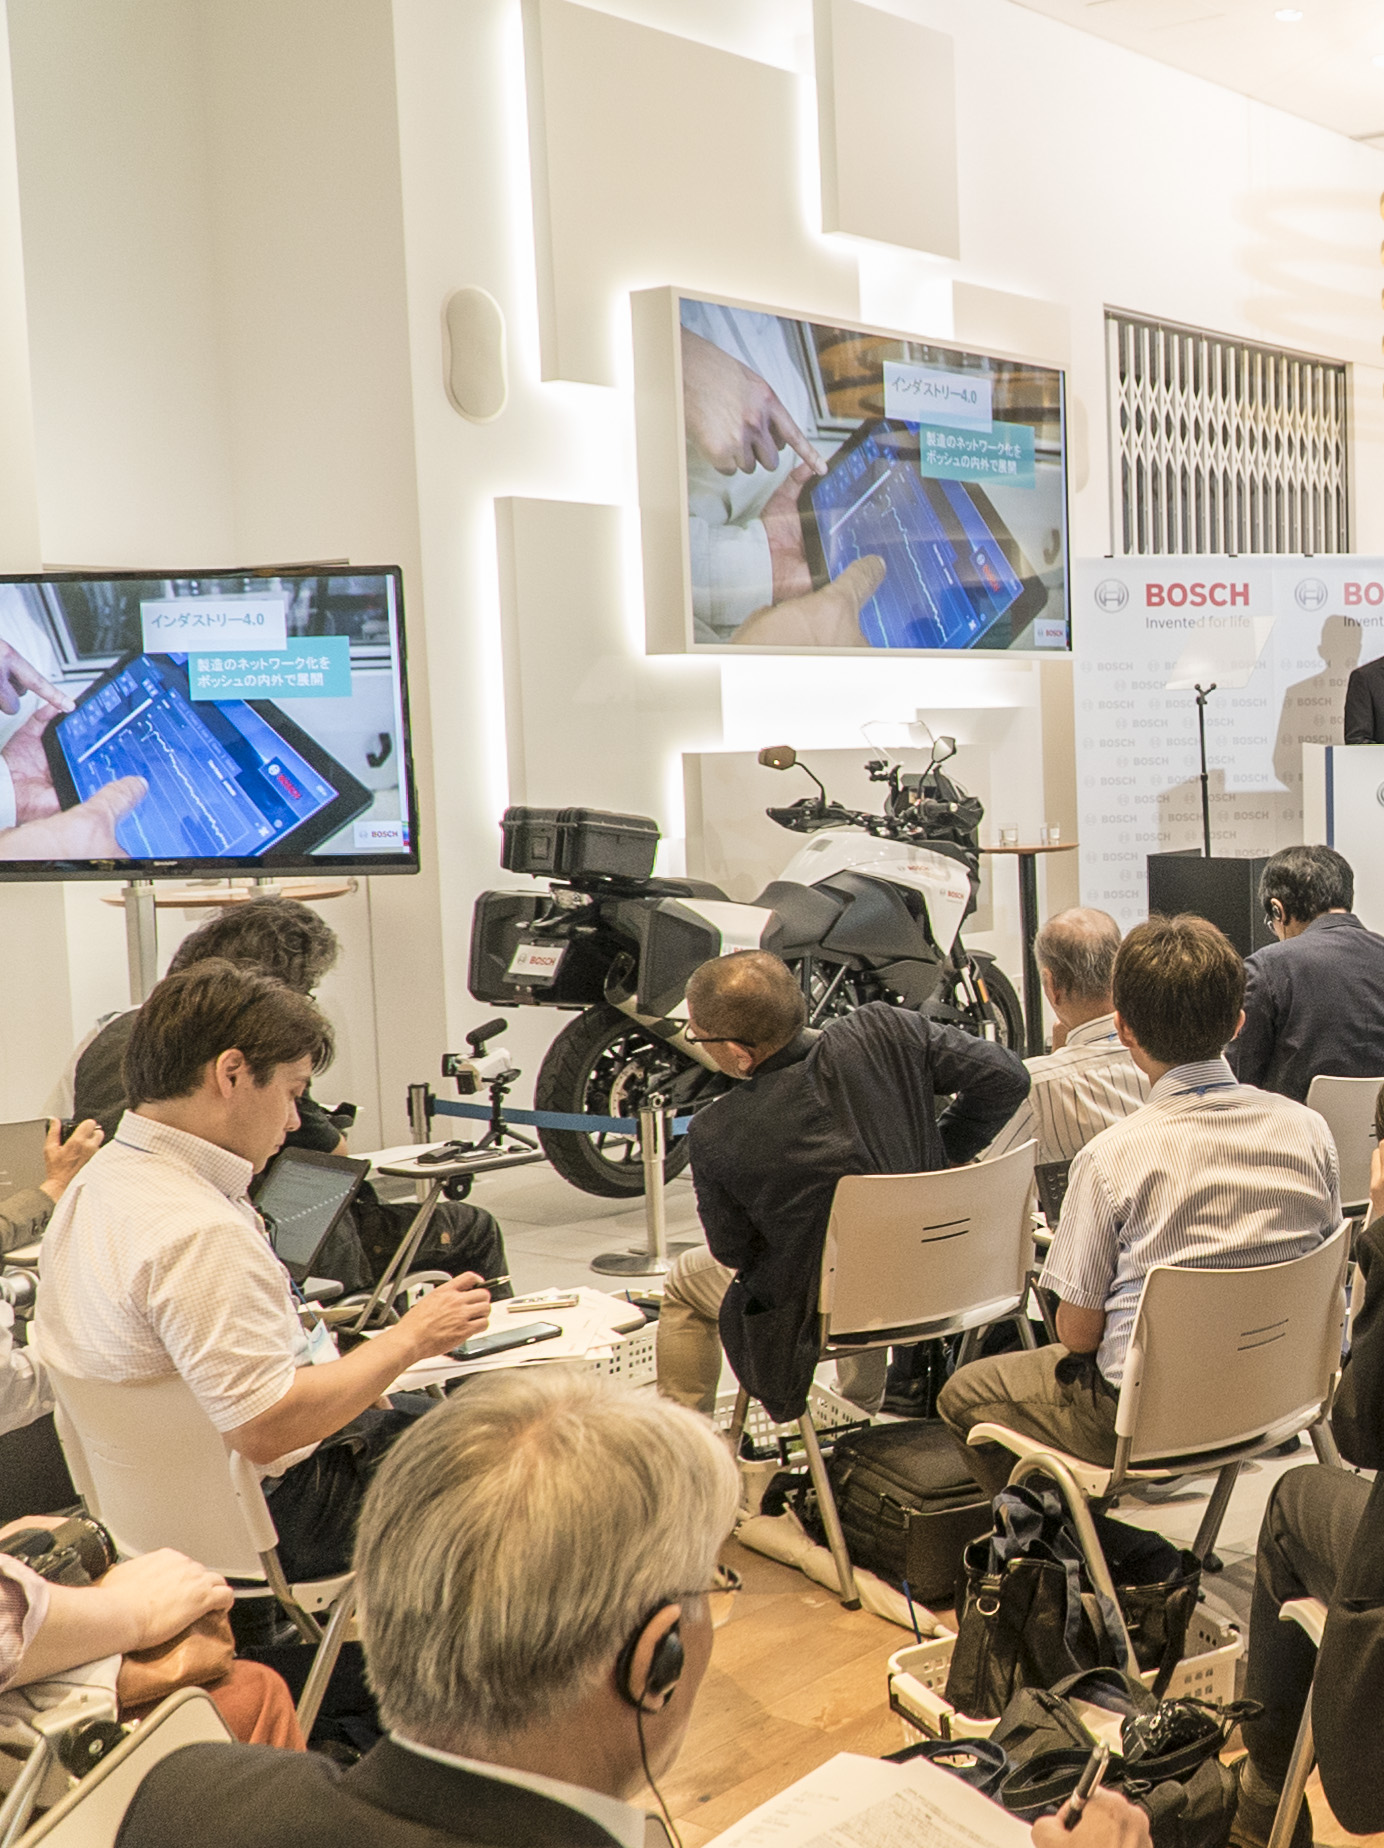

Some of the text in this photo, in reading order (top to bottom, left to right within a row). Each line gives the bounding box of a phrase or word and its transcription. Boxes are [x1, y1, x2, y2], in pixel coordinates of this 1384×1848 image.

[893, 376, 978, 404] インダストリー4.0
[926, 431, 1022, 459] 製造のネットワーク化を
[1146, 582, 1249, 607] BOSCH
[151, 613, 265, 628] インダストリー4.0
[1146, 615, 1250, 629] Invented for life
[197, 656, 331, 673] 製造のネットワーク化を
[1097, 662, 1134, 671] BOSCH
[197, 672, 324, 688] ボッシュの内外で展開
[1131, 680, 1167, 689] BOSCH
[1098, 700, 1135, 709] BOSCH
[1231, 699, 1267, 708] BOSCH
[1297, 698, 1331, 707] BOSCH
[1132, 719, 1168, 728] BOSCH
[1205, 718, 1235, 727] OSCH
[1099, 739, 1135, 748] BOSCH
[1232, 736, 1268, 745] BOSCH
[1133, 757, 1169, 766] BOSCH
[1207, 756, 1236, 764] OSCH
[1101, 777, 1136, 786] BOSCH
[1233, 774, 1269, 783] BOSCH
[1134, 795, 1170, 804] BOSCH
[1208, 794, 1236, 803] OSCH
[1101, 814, 1137, 824] BOSCH
[1234, 811, 1269, 820] BOSCH
[1135, 832, 1171, 841] BOSCH
[1209, 830, 1237, 840] OSCH
[1102, 852, 1138, 862] BOSCH
[1103, 890, 1139, 900] BOSCH
[529, 955, 556, 966] BOSCH
